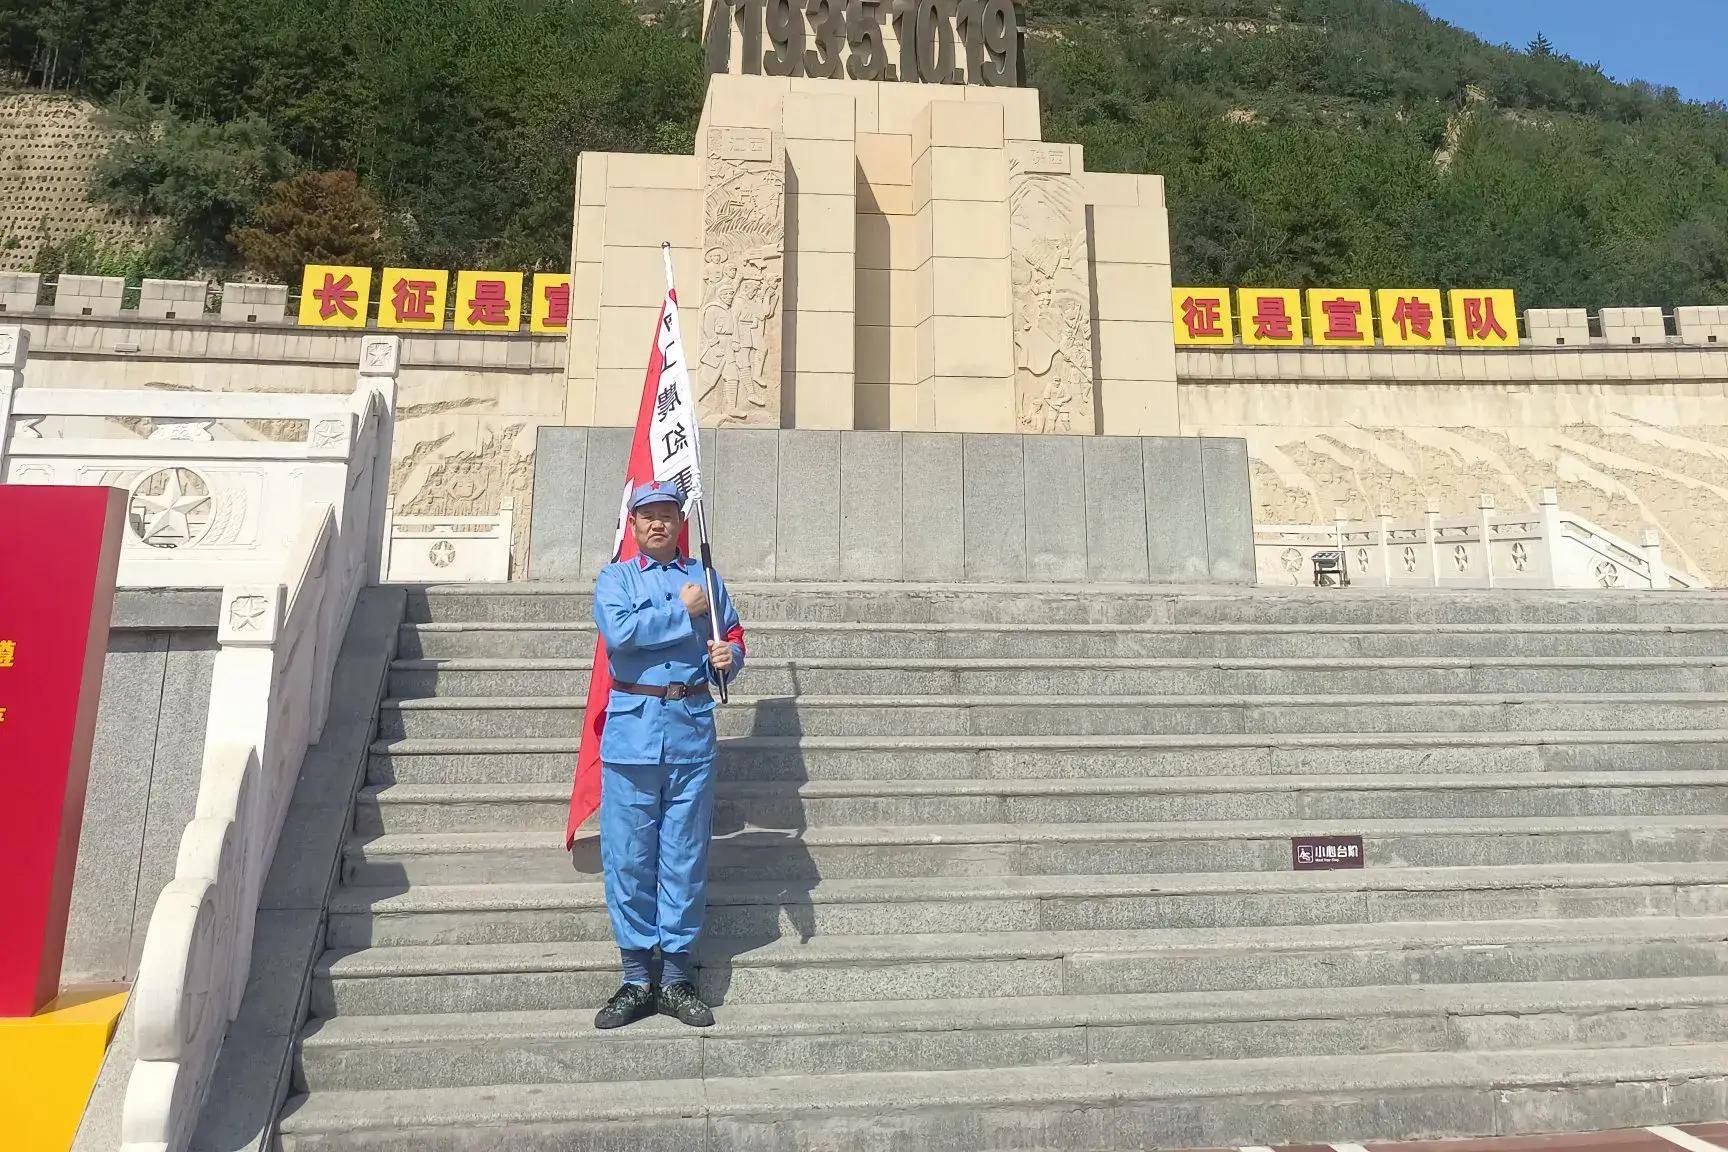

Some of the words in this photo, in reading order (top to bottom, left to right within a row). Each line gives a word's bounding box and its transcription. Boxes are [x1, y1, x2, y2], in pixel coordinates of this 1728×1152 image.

[1181, 296, 1507, 341] 征是宣传队
[1315, 845, 1358, 858] 小心台阶
